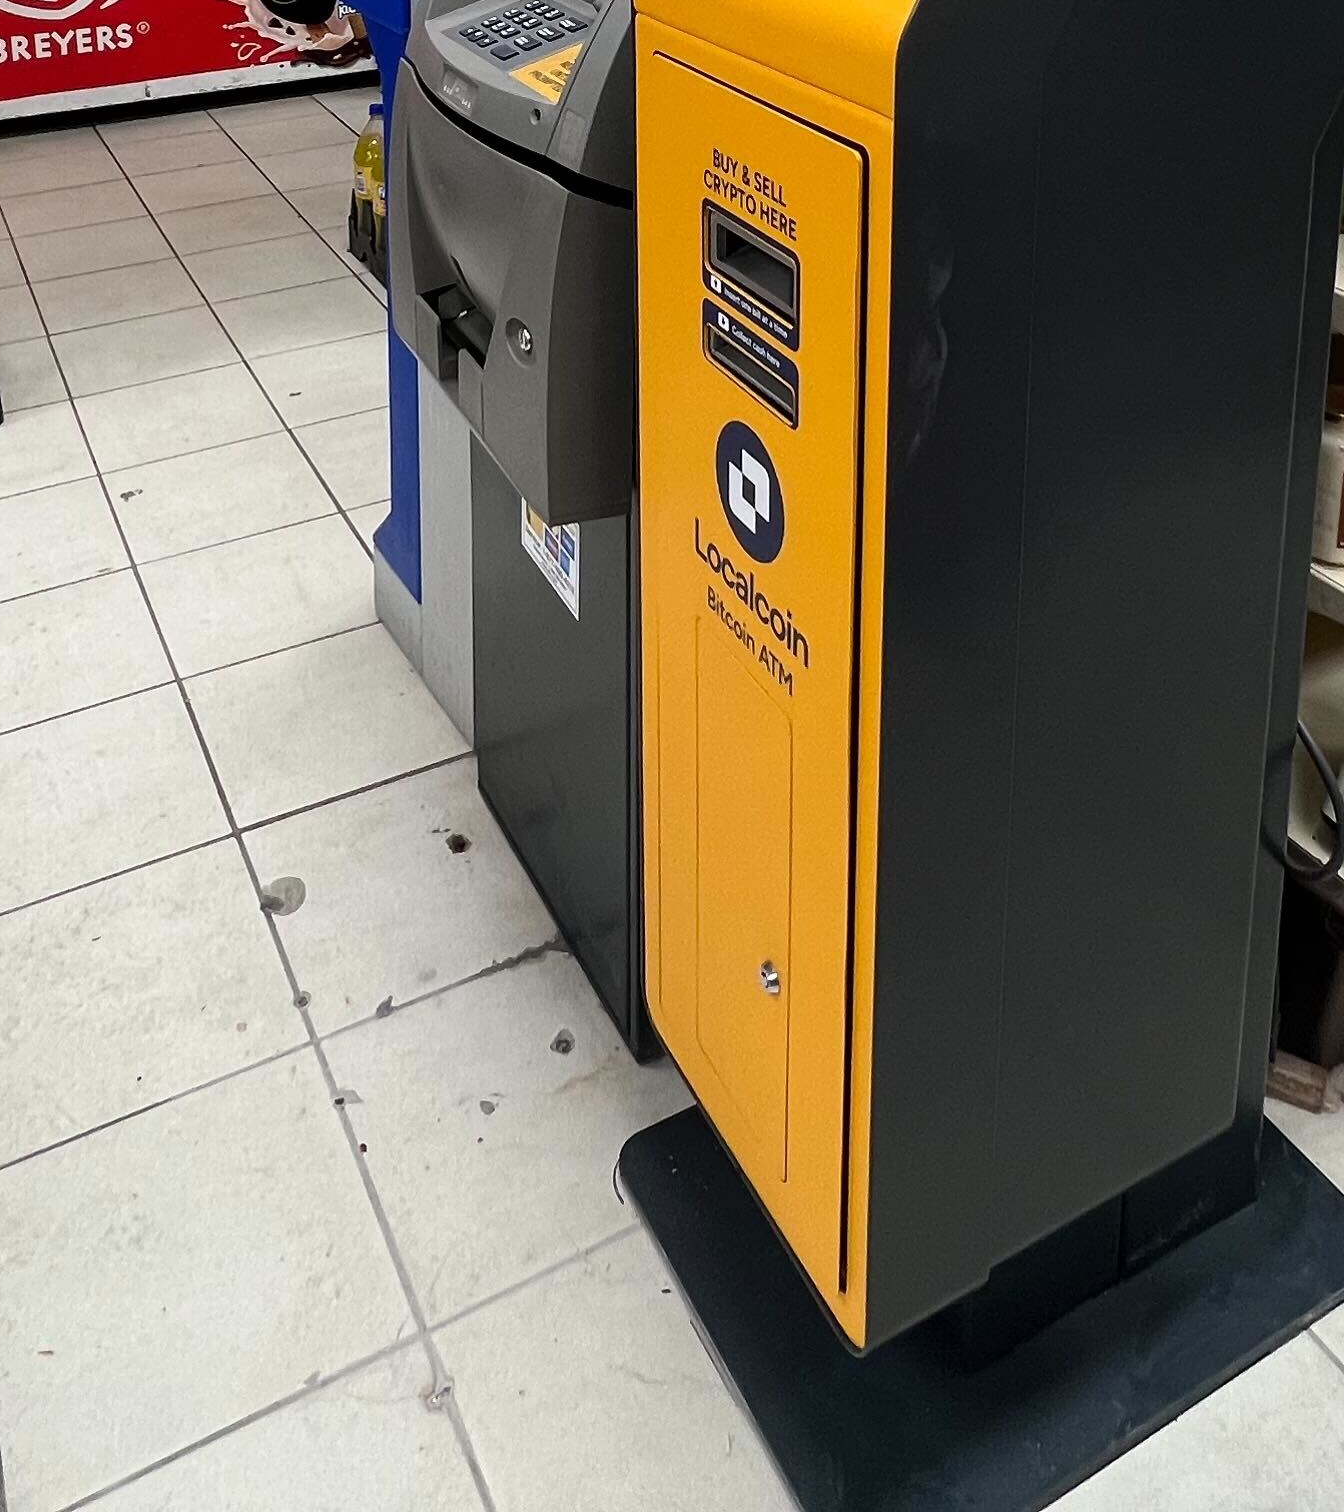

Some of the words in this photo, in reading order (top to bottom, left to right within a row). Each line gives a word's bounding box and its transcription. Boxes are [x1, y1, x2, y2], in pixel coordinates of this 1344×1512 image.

[703, 168, 757, 216] CRYPTO
[759, 200, 798, 242] HERE
[712, 147, 739, 178] BUY
[741, 165, 752, 186] &
[753, 171, 787, 208] SELL
[723, 285, 741, 307] Insert
[731, 322, 753, 350] Collect
[752, 338, 768, 359] cash
[766, 348, 782, 369] here
[694, 516, 809, 669] Localcoin
[707, 584, 755, 656] Bitcoin
[758, 643, 793, 697] ATM
